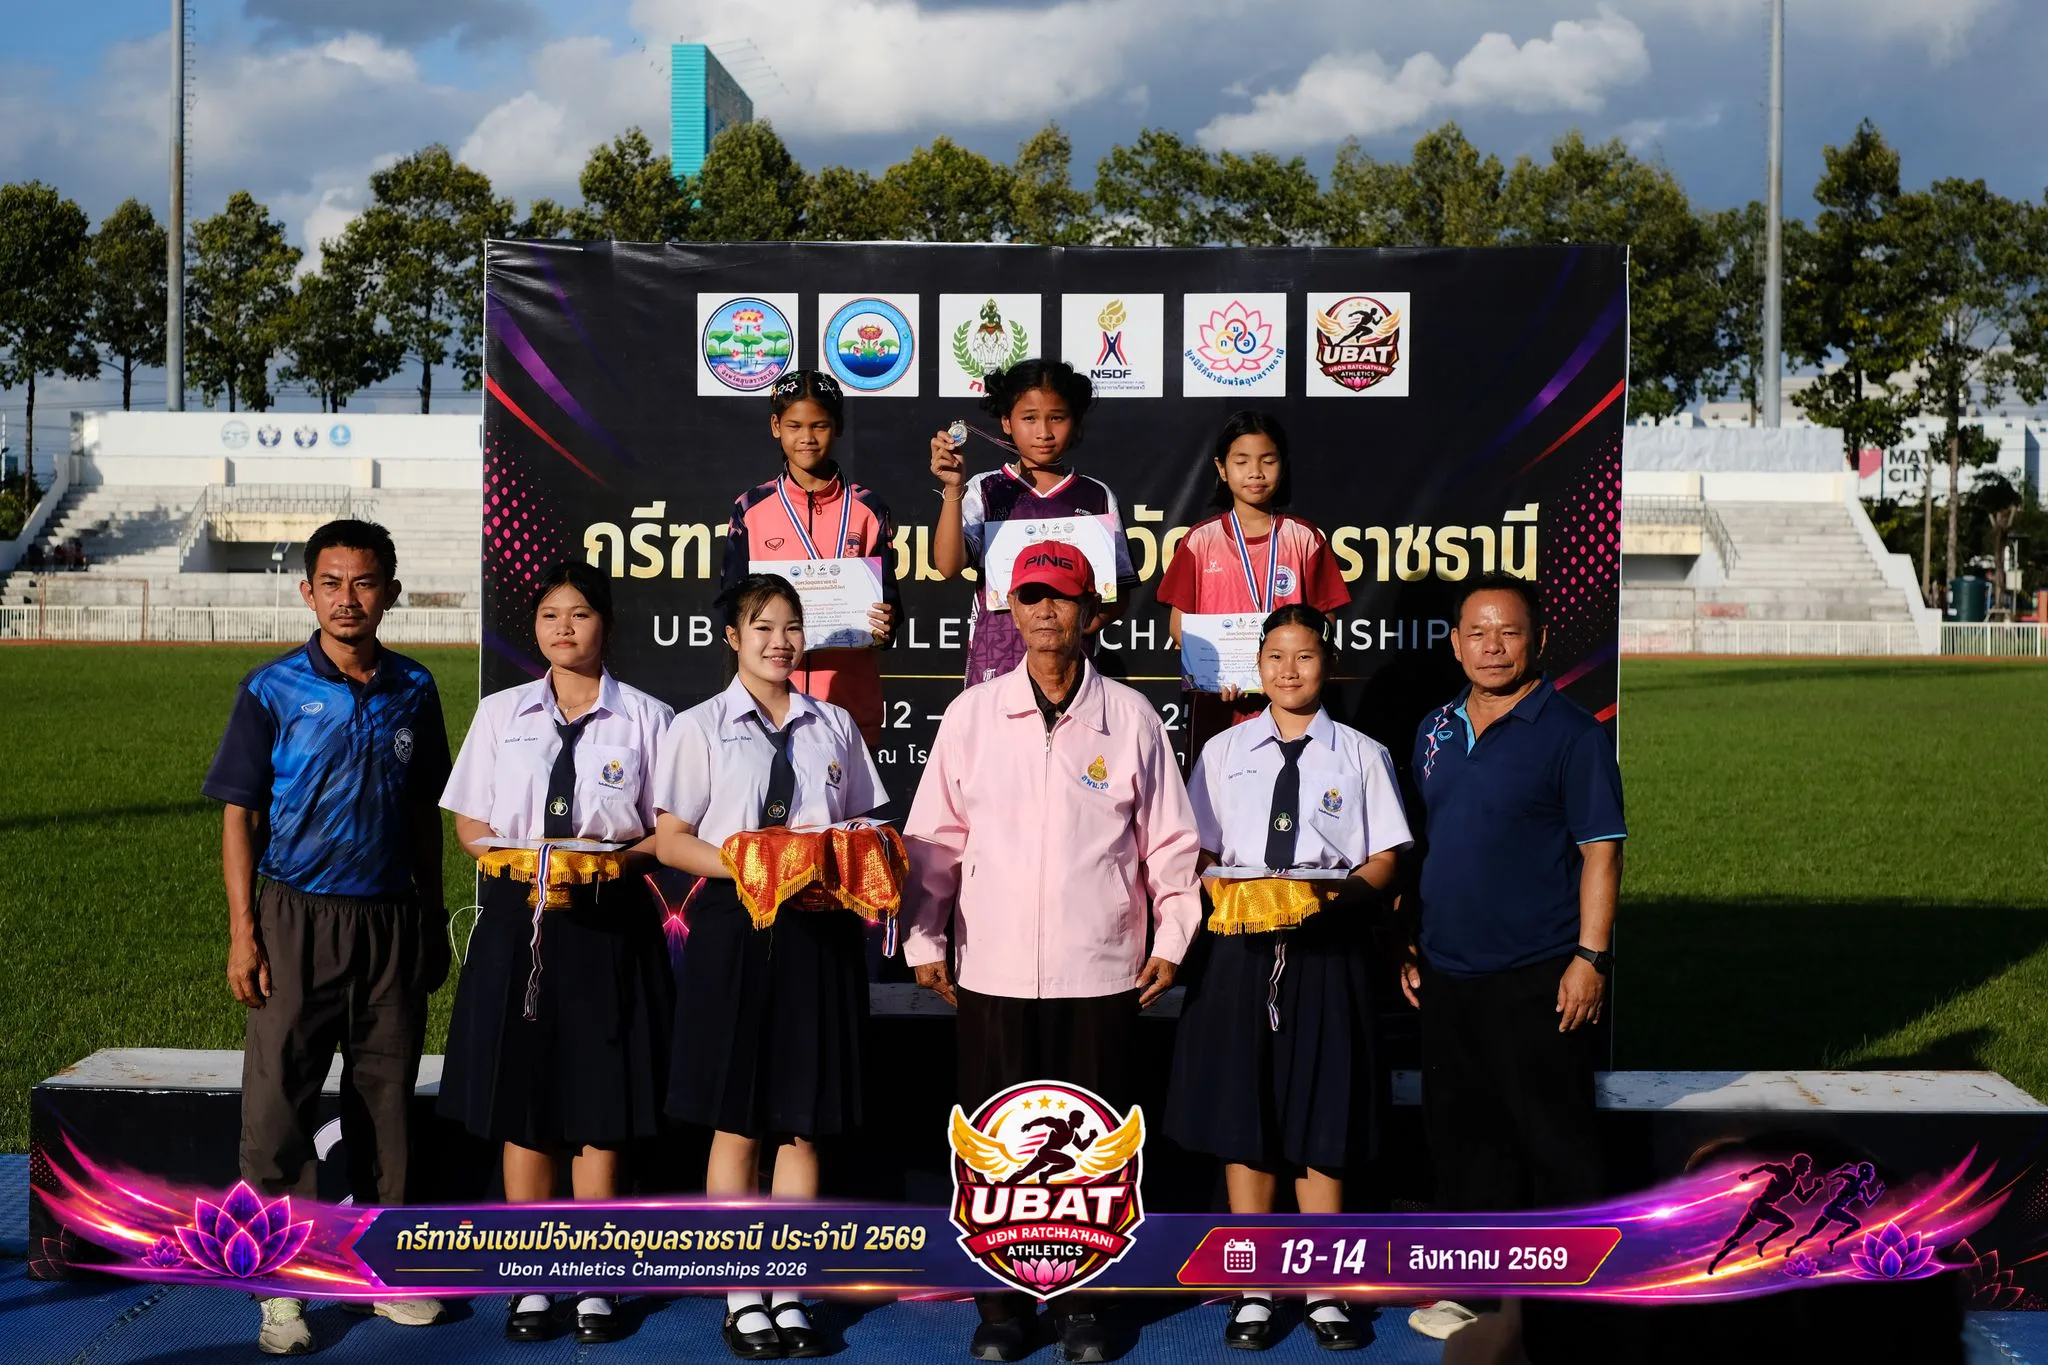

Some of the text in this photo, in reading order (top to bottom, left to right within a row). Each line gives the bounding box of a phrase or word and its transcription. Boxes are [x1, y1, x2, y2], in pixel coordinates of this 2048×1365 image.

[1323, 346, 1393, 363] UBAT
[1090, 369, 1132, 379] NSDF
[1347, 364, 1389, 373] RATCHATHANI
[1023, 552, 1074, 570] PING
[653, 615, 713, 647] UB
